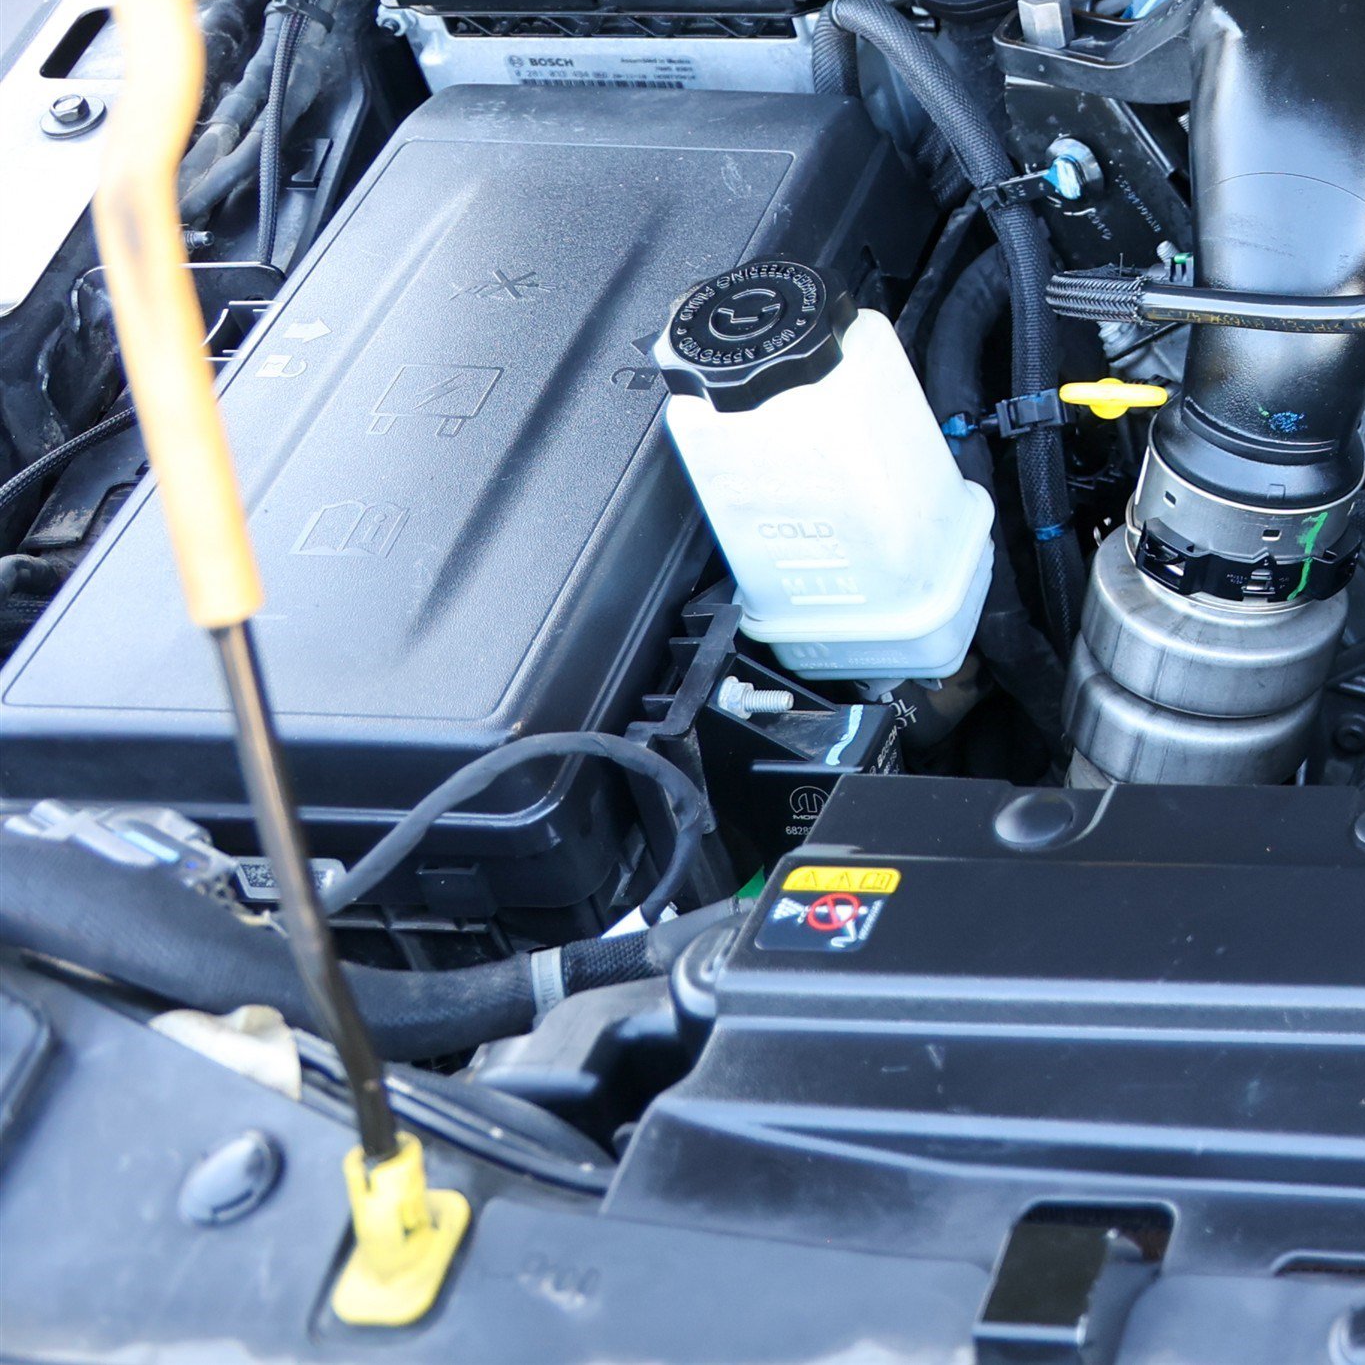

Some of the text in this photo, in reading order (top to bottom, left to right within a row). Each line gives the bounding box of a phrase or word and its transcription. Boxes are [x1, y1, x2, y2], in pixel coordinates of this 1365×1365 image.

[529, 57, 574, 67] BOSCH
[680, 263, 818, 322] POWER STEERING FLUID
[758, 521, 834, 539] COLD
[781, 575, 858, 595] MIN
[877, 725, 898, 769] BOSCH
